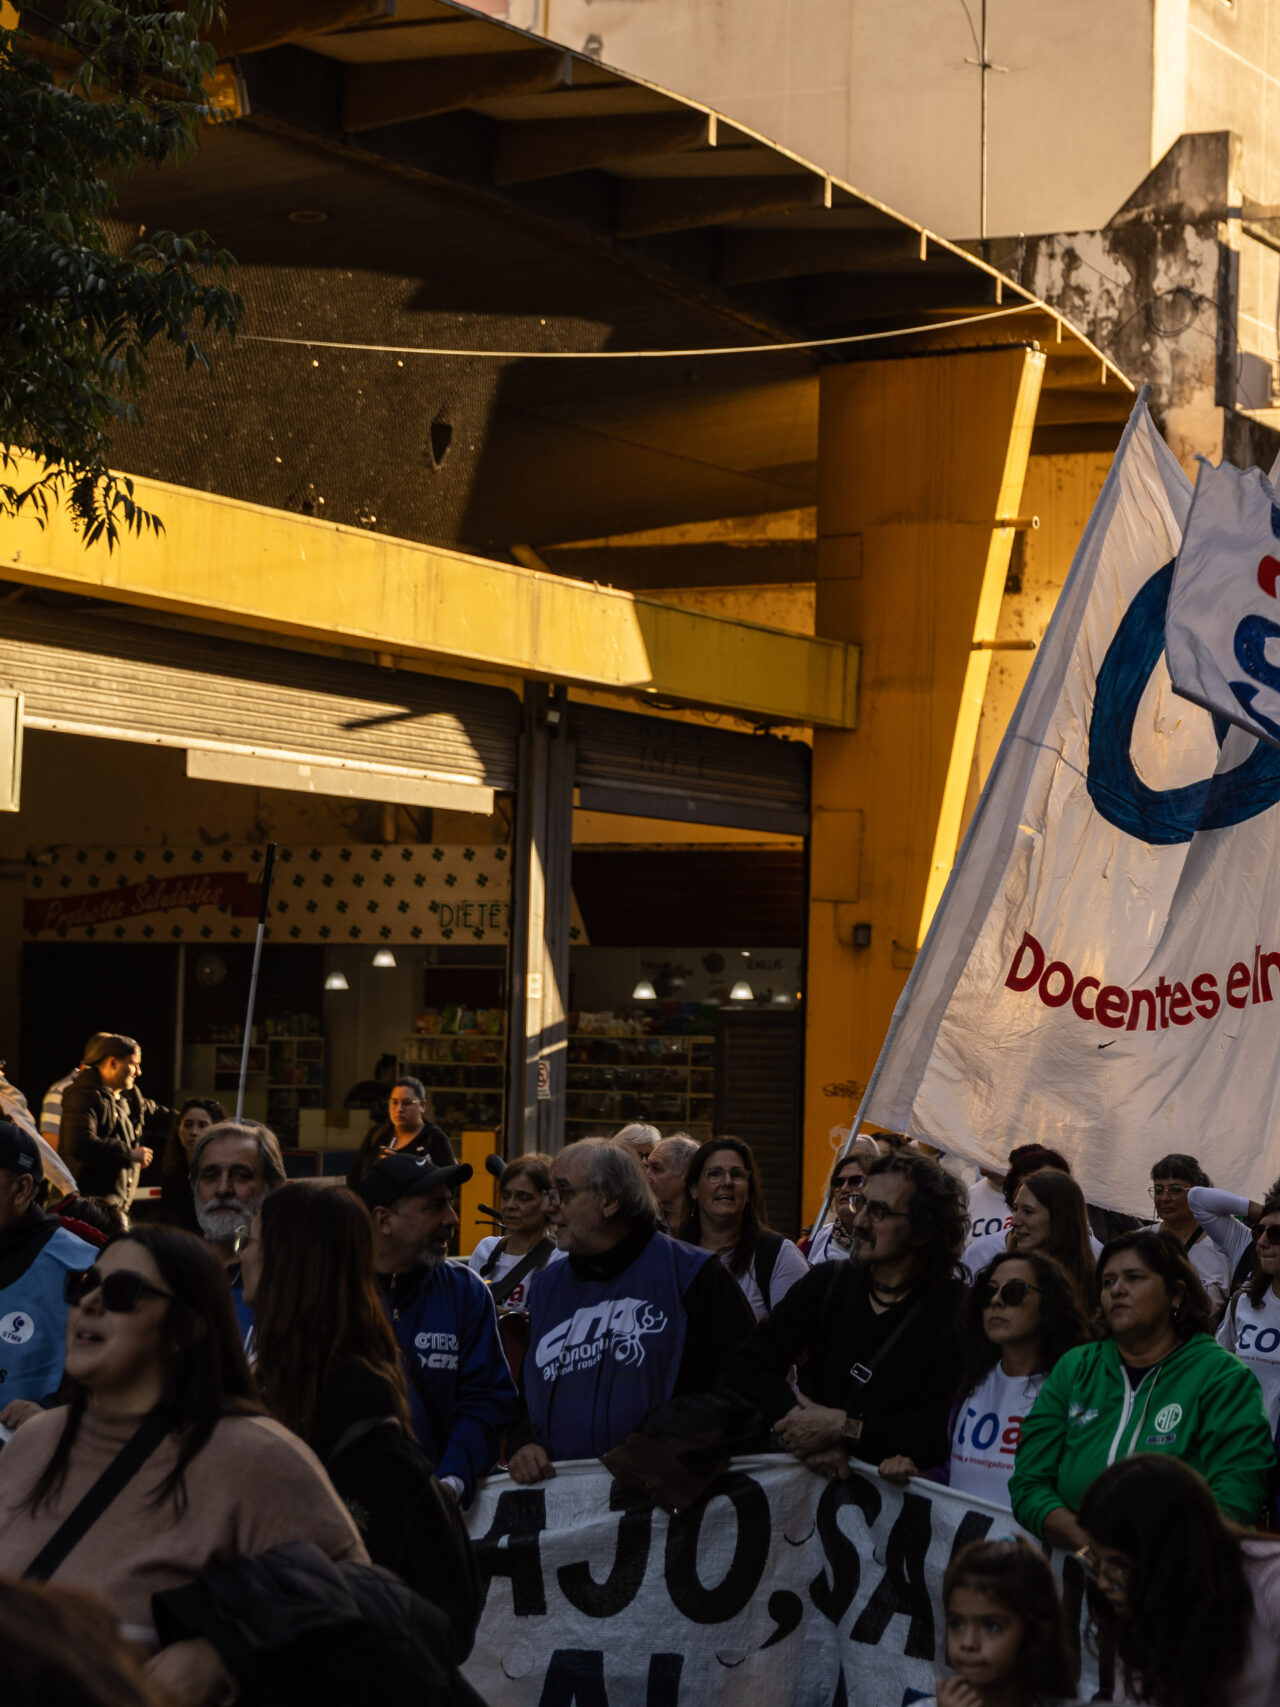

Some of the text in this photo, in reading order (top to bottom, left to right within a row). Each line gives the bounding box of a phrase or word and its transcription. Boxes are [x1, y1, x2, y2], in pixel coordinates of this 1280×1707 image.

[43, 879, 223, 929] Productos Saludables
[1005, 931, 1220, 1031] Docentes
